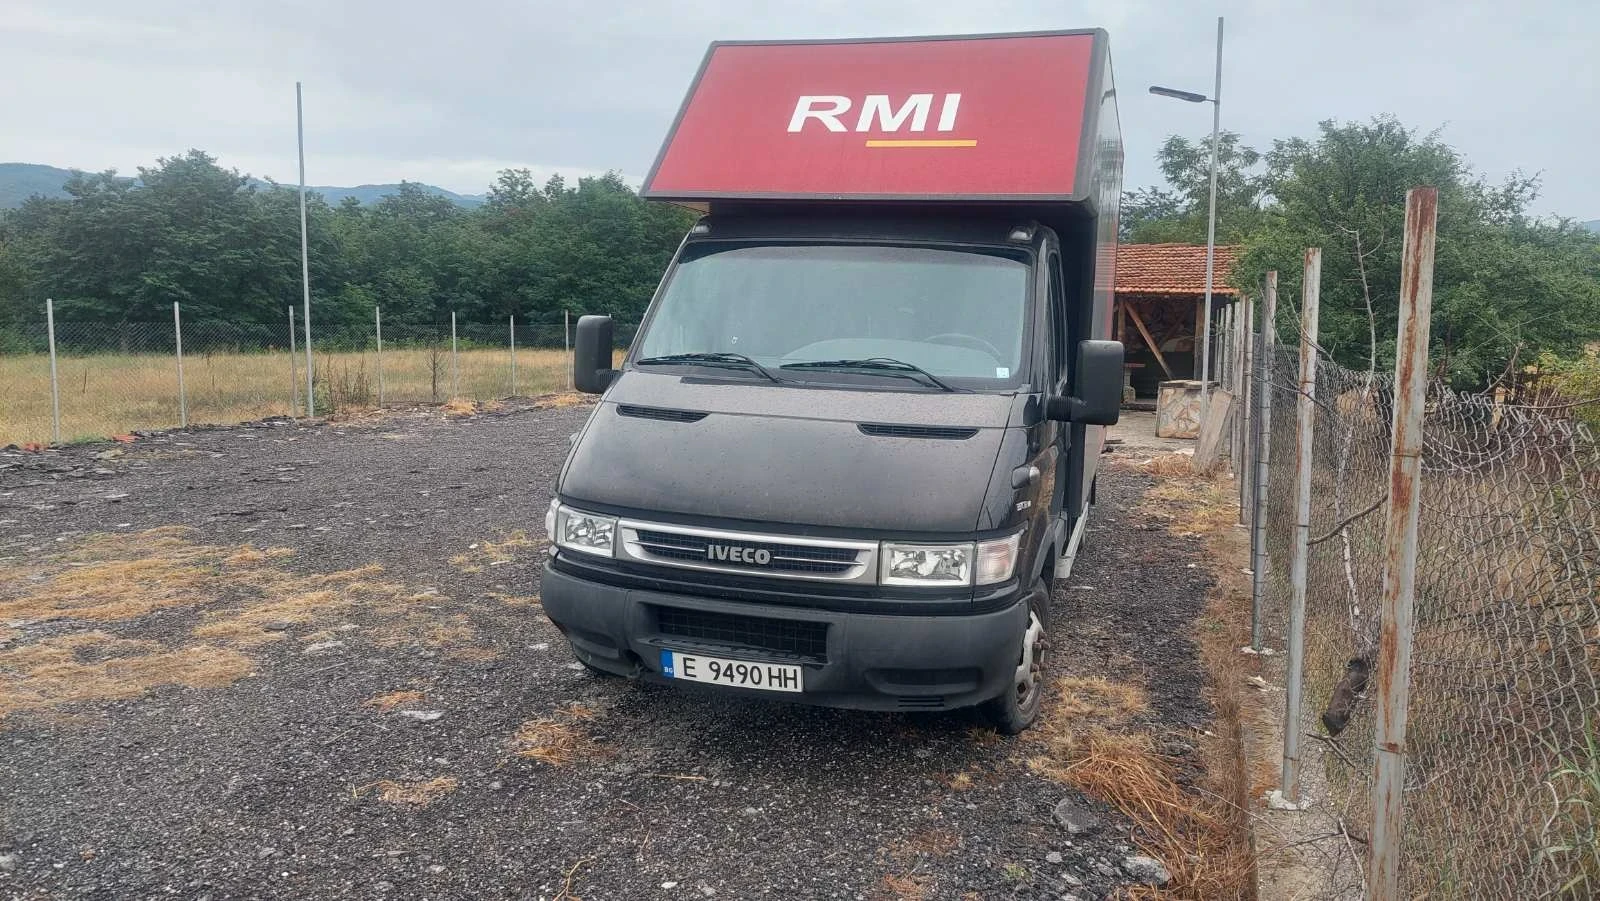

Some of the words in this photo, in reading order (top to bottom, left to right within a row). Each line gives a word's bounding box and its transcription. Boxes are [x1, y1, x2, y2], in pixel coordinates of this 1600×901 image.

[787, 93, 962, 132] RMI
[707, 544, 771, 565] IVECO
[663, 666, 674, 674] BG
[683, 657, 697, 678] E
[708, 661, 763, 686] 9490
[767, 666, 798, 689] HH
